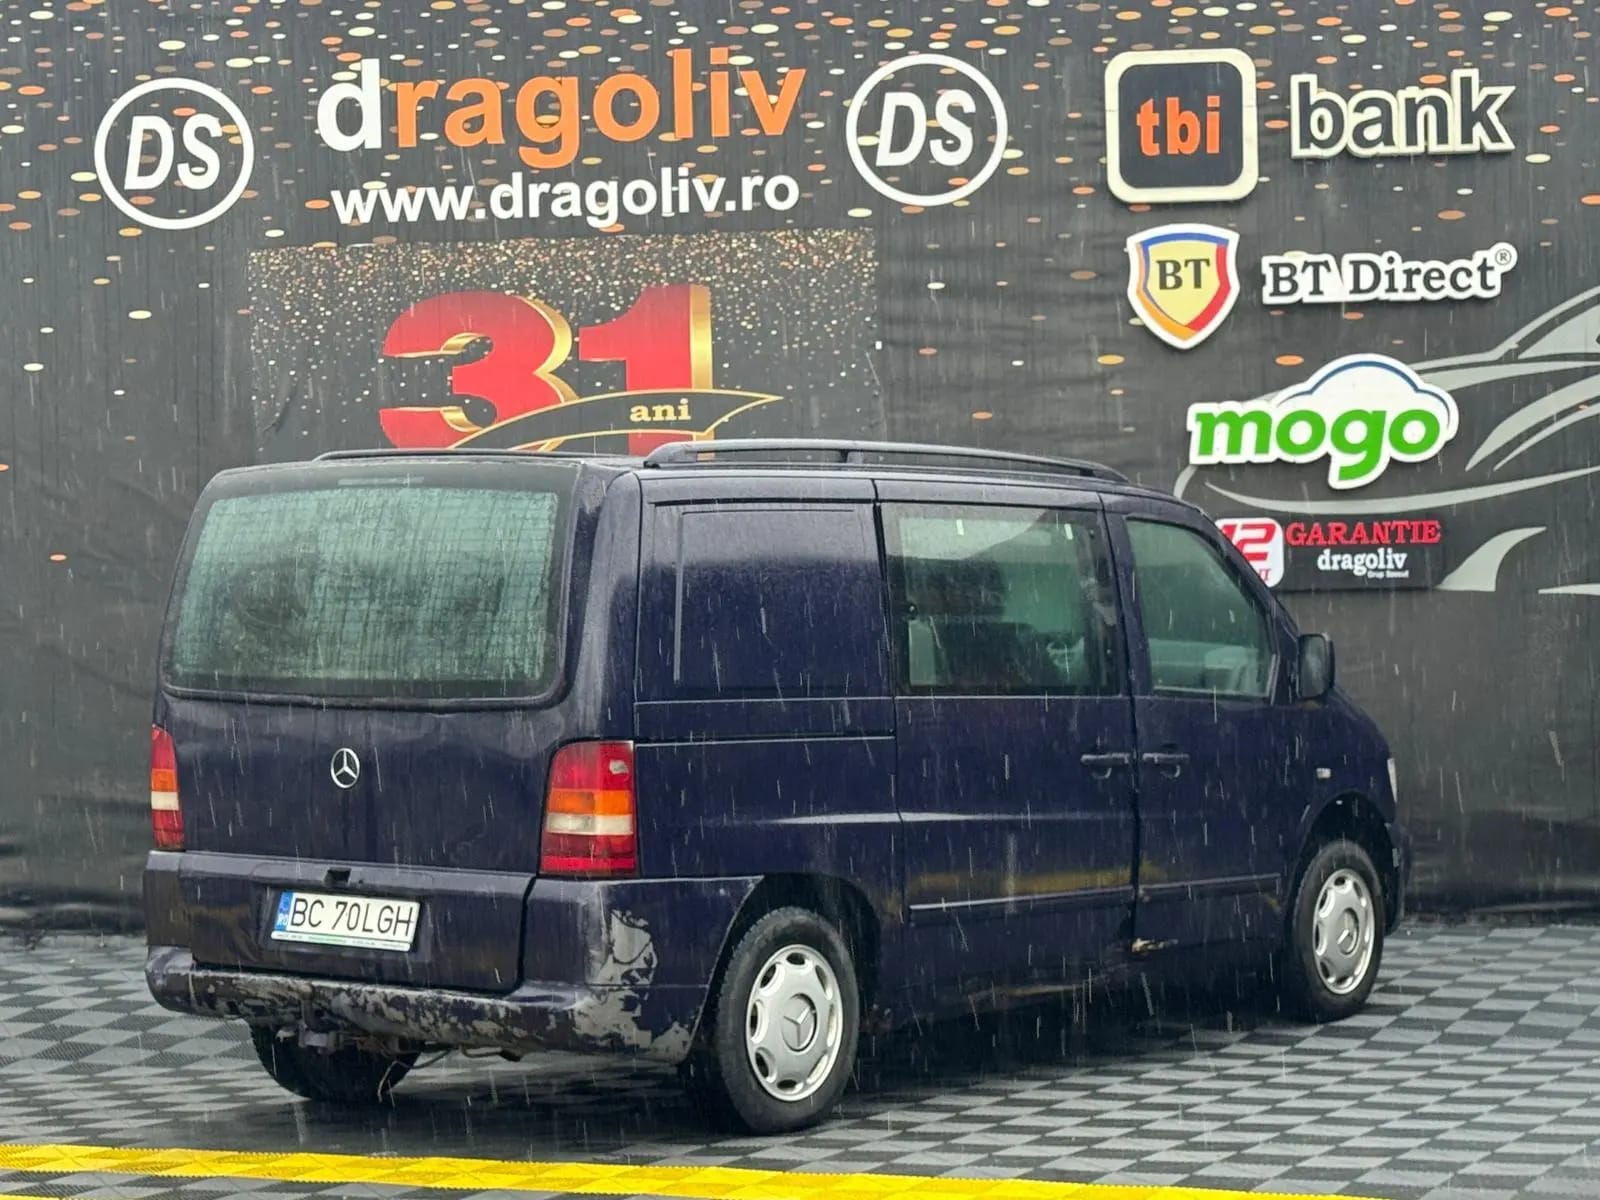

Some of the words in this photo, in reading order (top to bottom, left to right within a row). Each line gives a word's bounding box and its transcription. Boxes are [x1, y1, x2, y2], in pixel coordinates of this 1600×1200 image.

[317, 47, 806, 168] dragoliv
[876, 89, 976, 167] DS
[1136, 95, 1221, 157] tbi
[1292, 70, 1514, 159] bank
[124, 114, 222, 192] DS
[331, 168, 799, 229] www.dragoliv.ro
[1156, 258, 1211, 291] BT
[1269, 260, 1332, 297] BT
[380, 284, 713, 458] 31
[629, 397, 691, 422] ani
[1196, 409, 1441, 481] mogo
[1285, 519, 1442, 547] GARANTIE
[1317, 547, 1408, 577] dragoliv
[290, 897, 325, 928] BC
[331, 900, 414, 936] 70LGH
